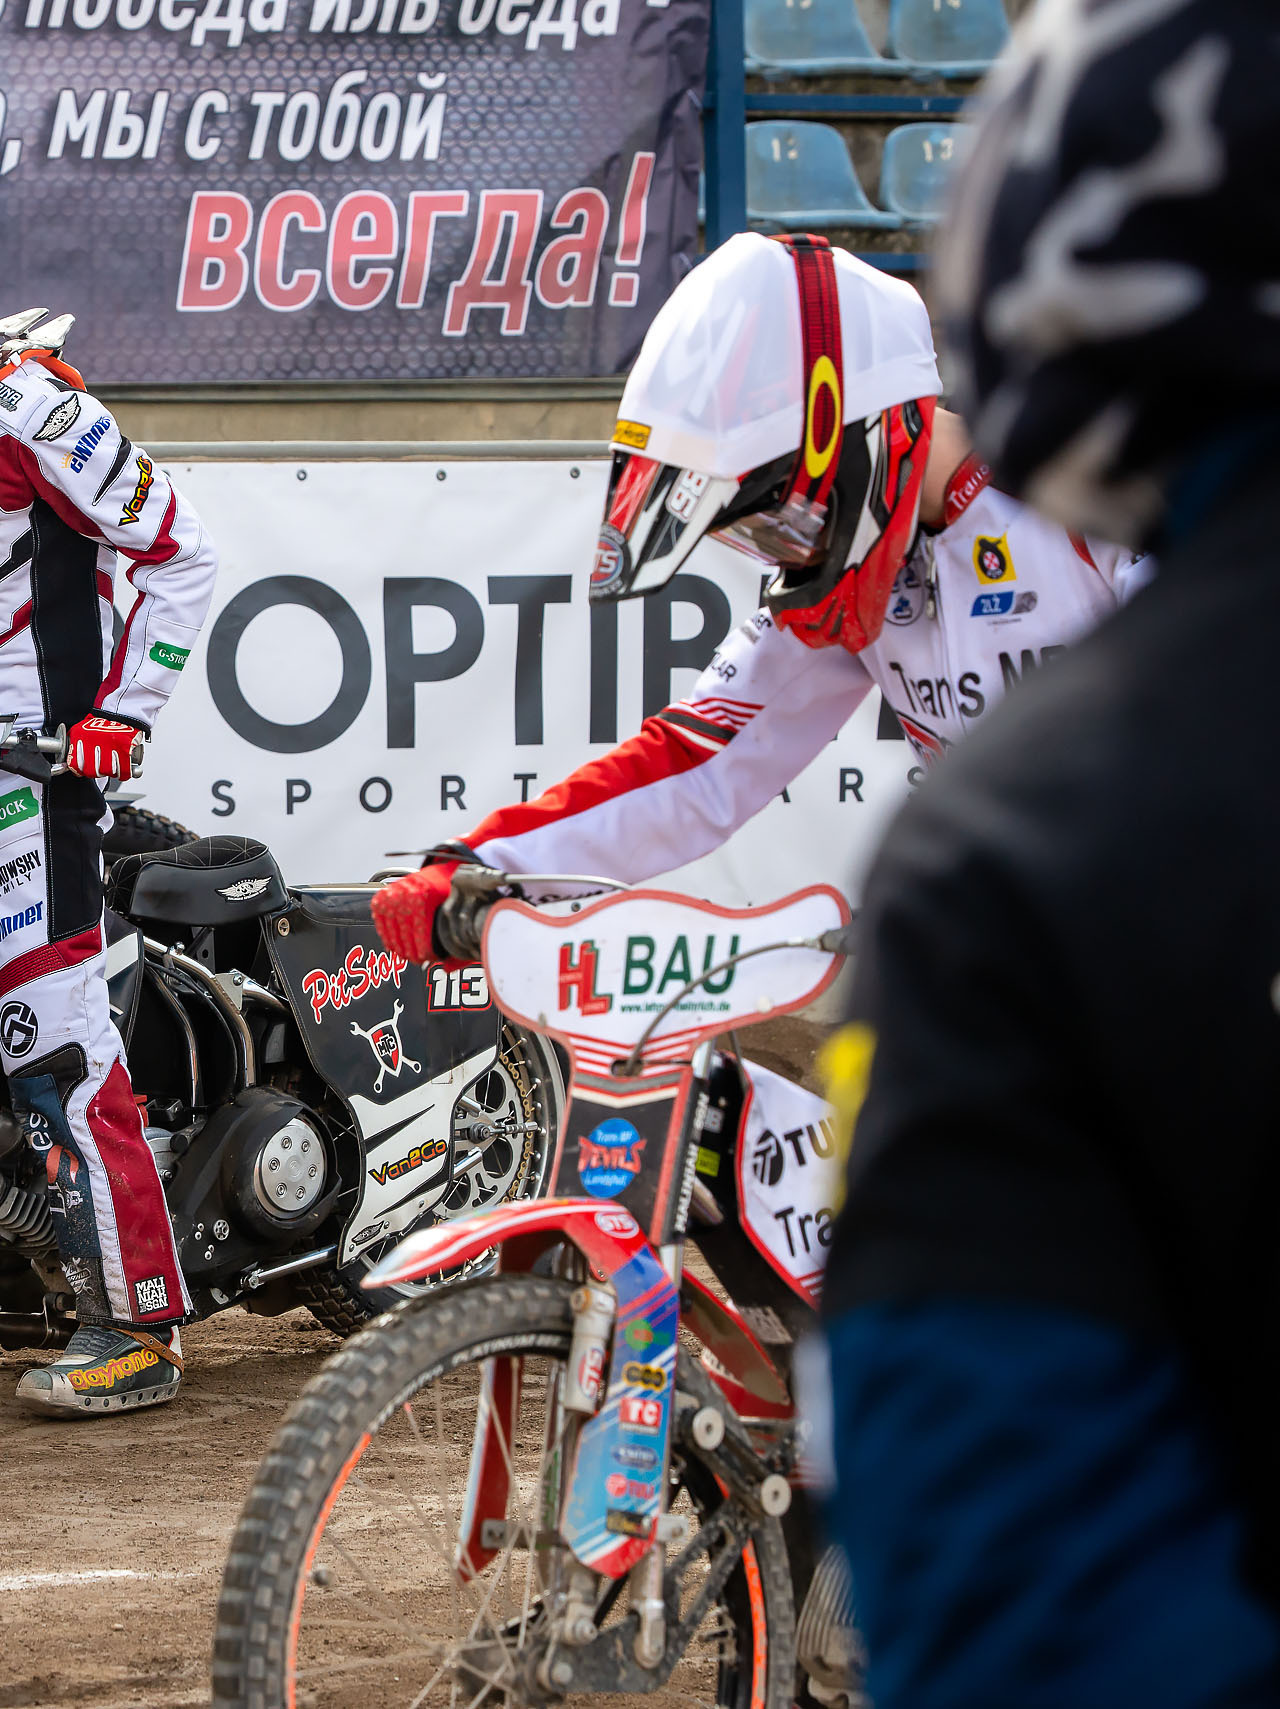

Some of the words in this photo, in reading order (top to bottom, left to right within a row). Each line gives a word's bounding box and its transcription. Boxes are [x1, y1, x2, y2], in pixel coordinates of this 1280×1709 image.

[47, 88, 168, 160] мы
[184, 89, 230, 160] с
[248, 69, 448, 162] тобой
[176, 151, 656, 336] всегда!
[889, 660, 986, 718] Trans
[302, 944, 409, 1024] PitStop
[427, 962, 491, 1012] 113
[558, 939, 613, 1017] HL
[622, 934, 740, 996] BAU
[367, 1138, 449, 1187] Van2Go
[135, 1276, 165, 1294] MALI
[138, 1288, 168, 1304] NIAK
[67, 1347, 159, 1391] daytona
